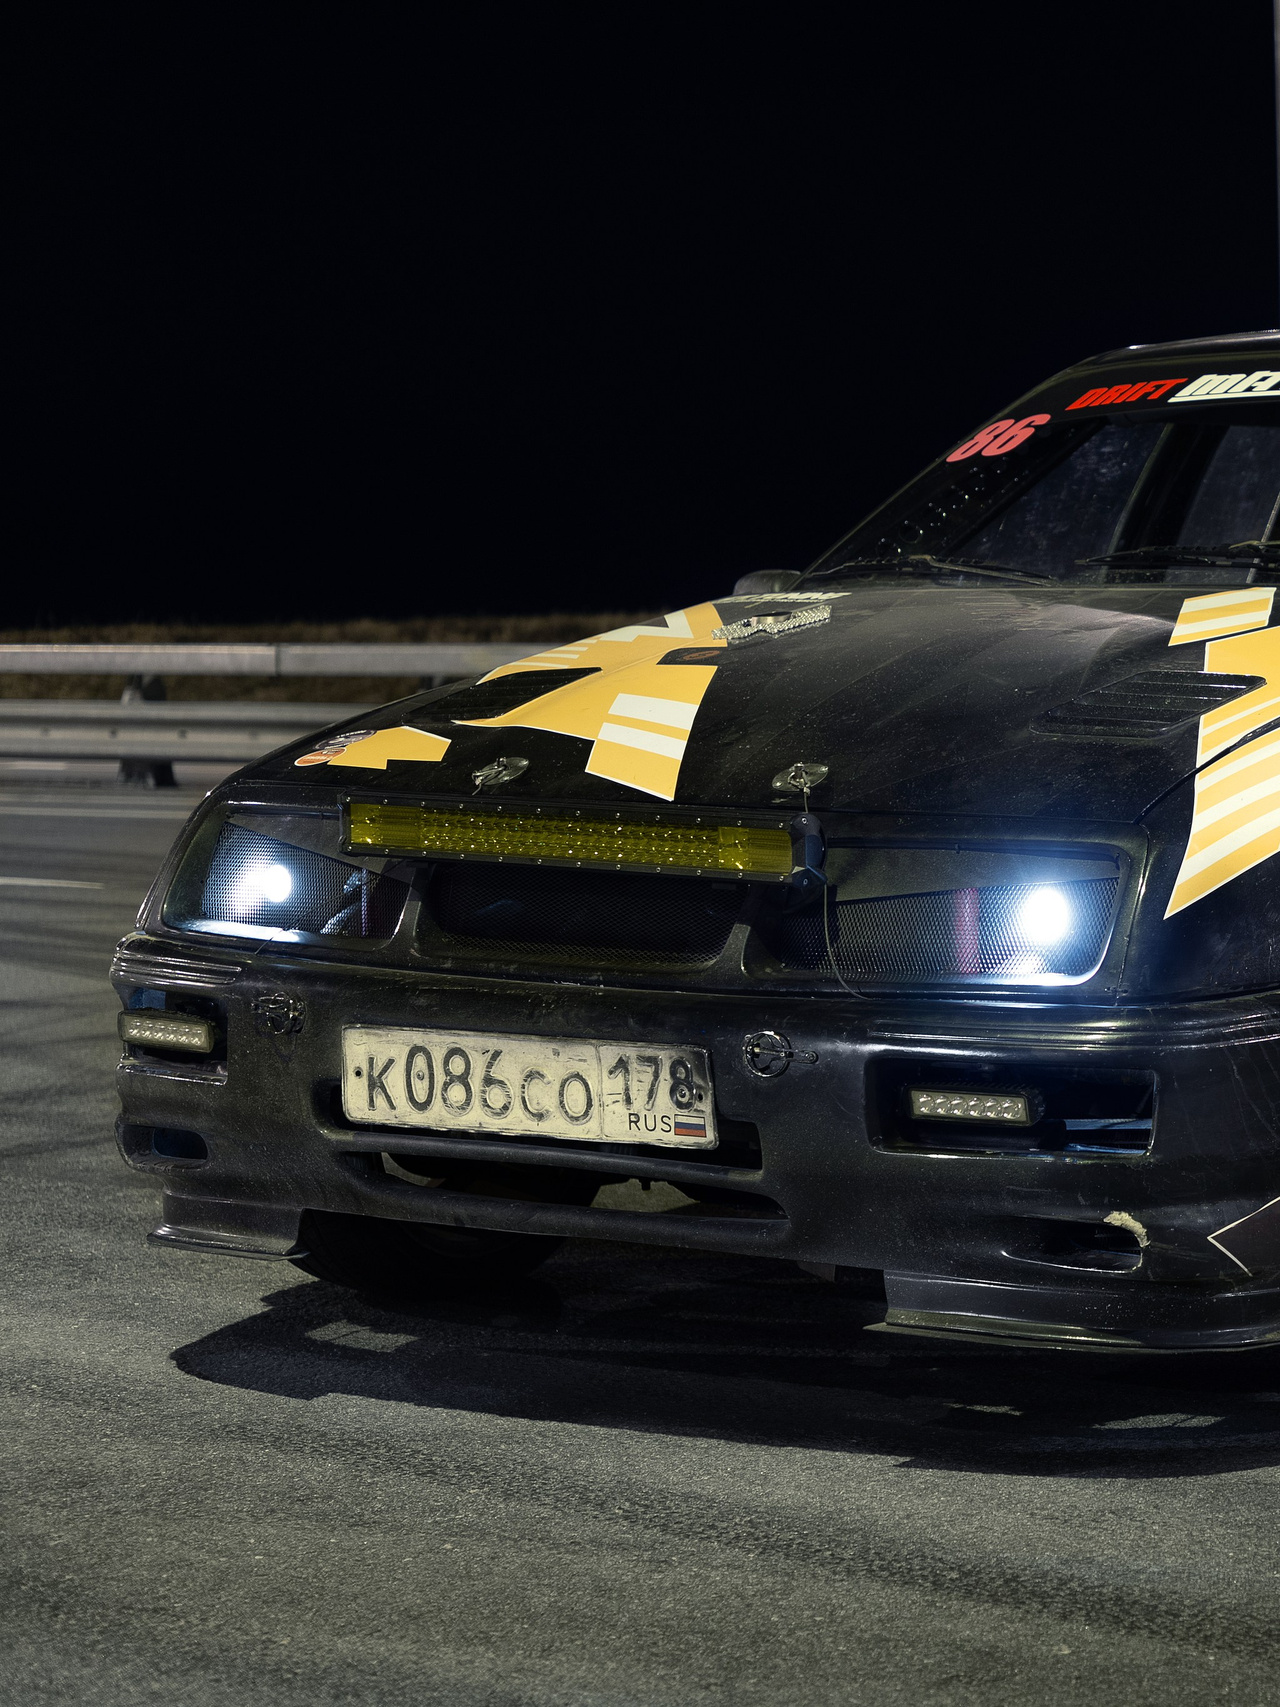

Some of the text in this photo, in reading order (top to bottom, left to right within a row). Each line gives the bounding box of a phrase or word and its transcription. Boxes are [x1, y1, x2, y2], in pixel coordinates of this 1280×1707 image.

[1065, 377, 1188, 411] DRIFT
[945, 413, 1052, 463] 86
[606, 1054, 697, 1112] 178
[628, 1112, 673, 1133] RUS
